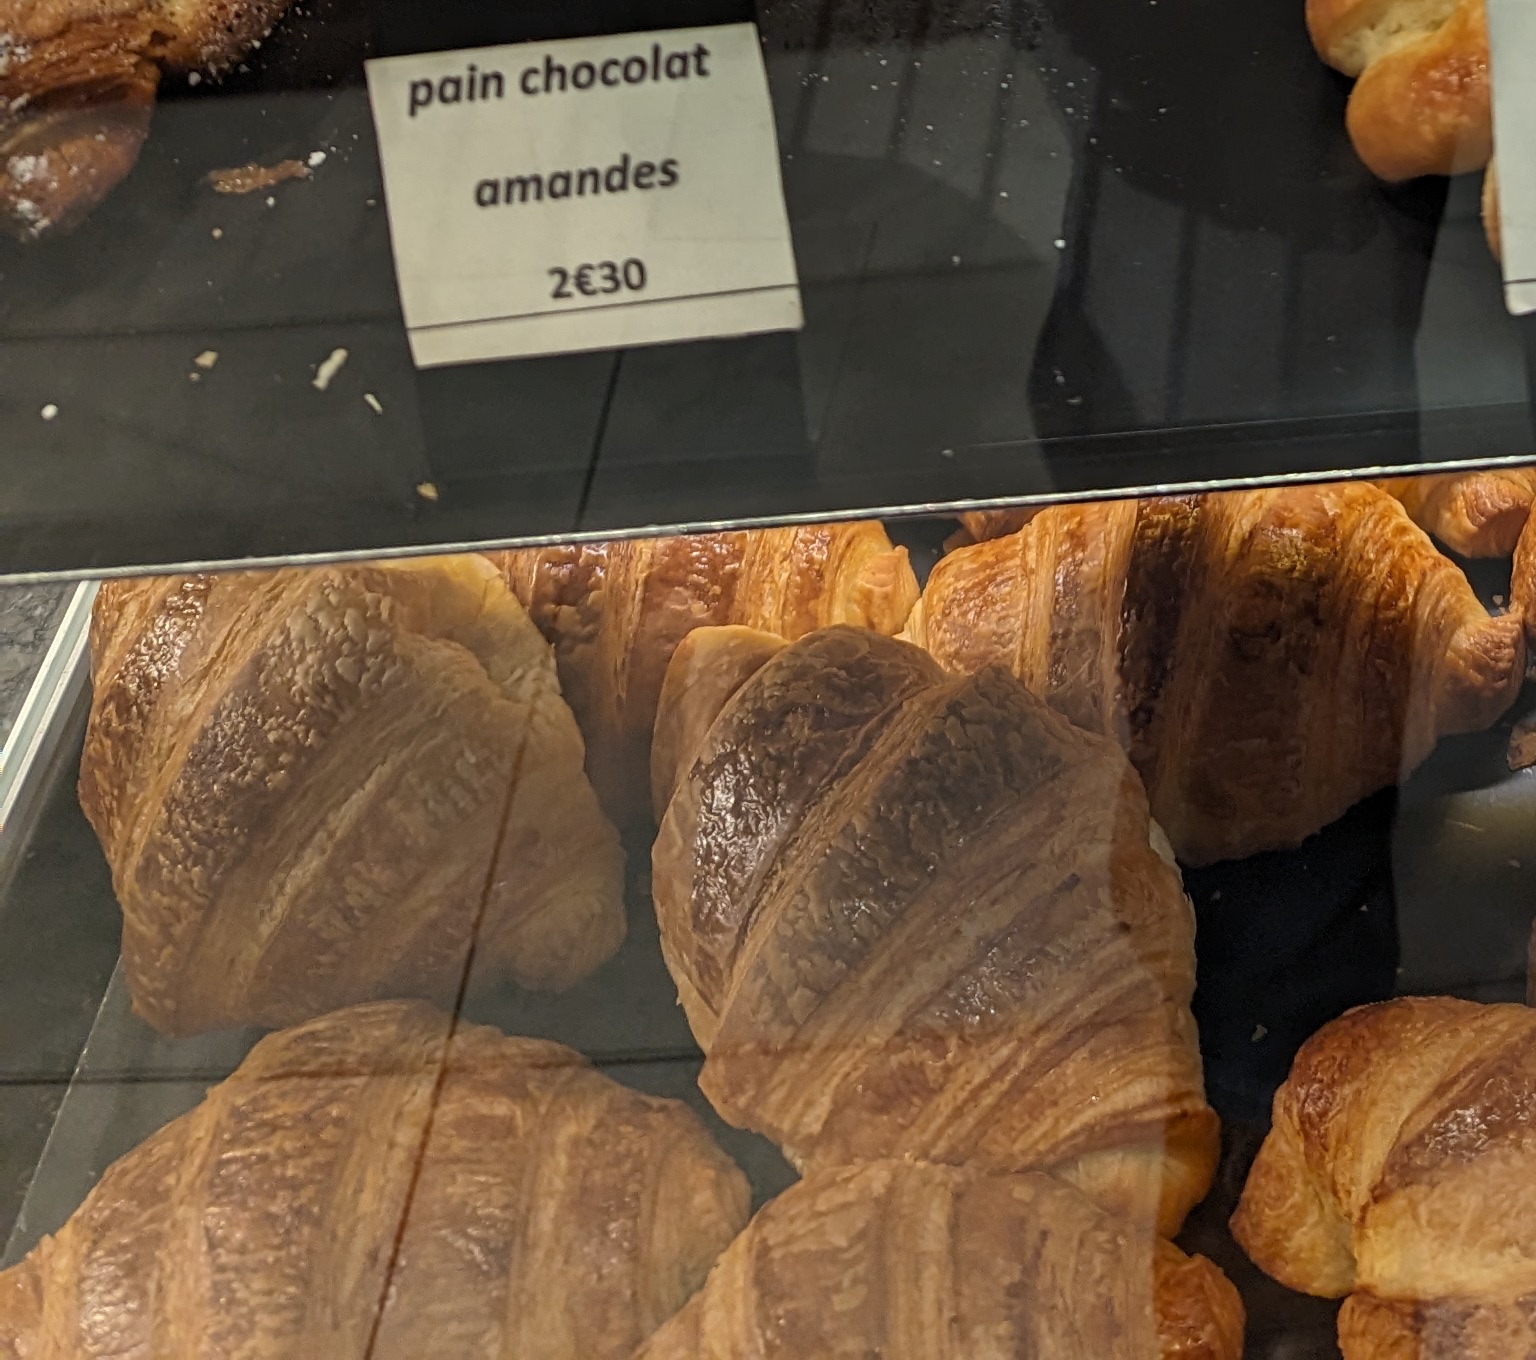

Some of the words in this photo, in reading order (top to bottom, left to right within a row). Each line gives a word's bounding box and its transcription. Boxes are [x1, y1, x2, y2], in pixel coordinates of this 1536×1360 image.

[408, 63, 505, 118] pain
[519, 42, 711, 96] chocolat
[474, 152, 680, 209] amandes
[548, 256, 647, 300] 2€30
